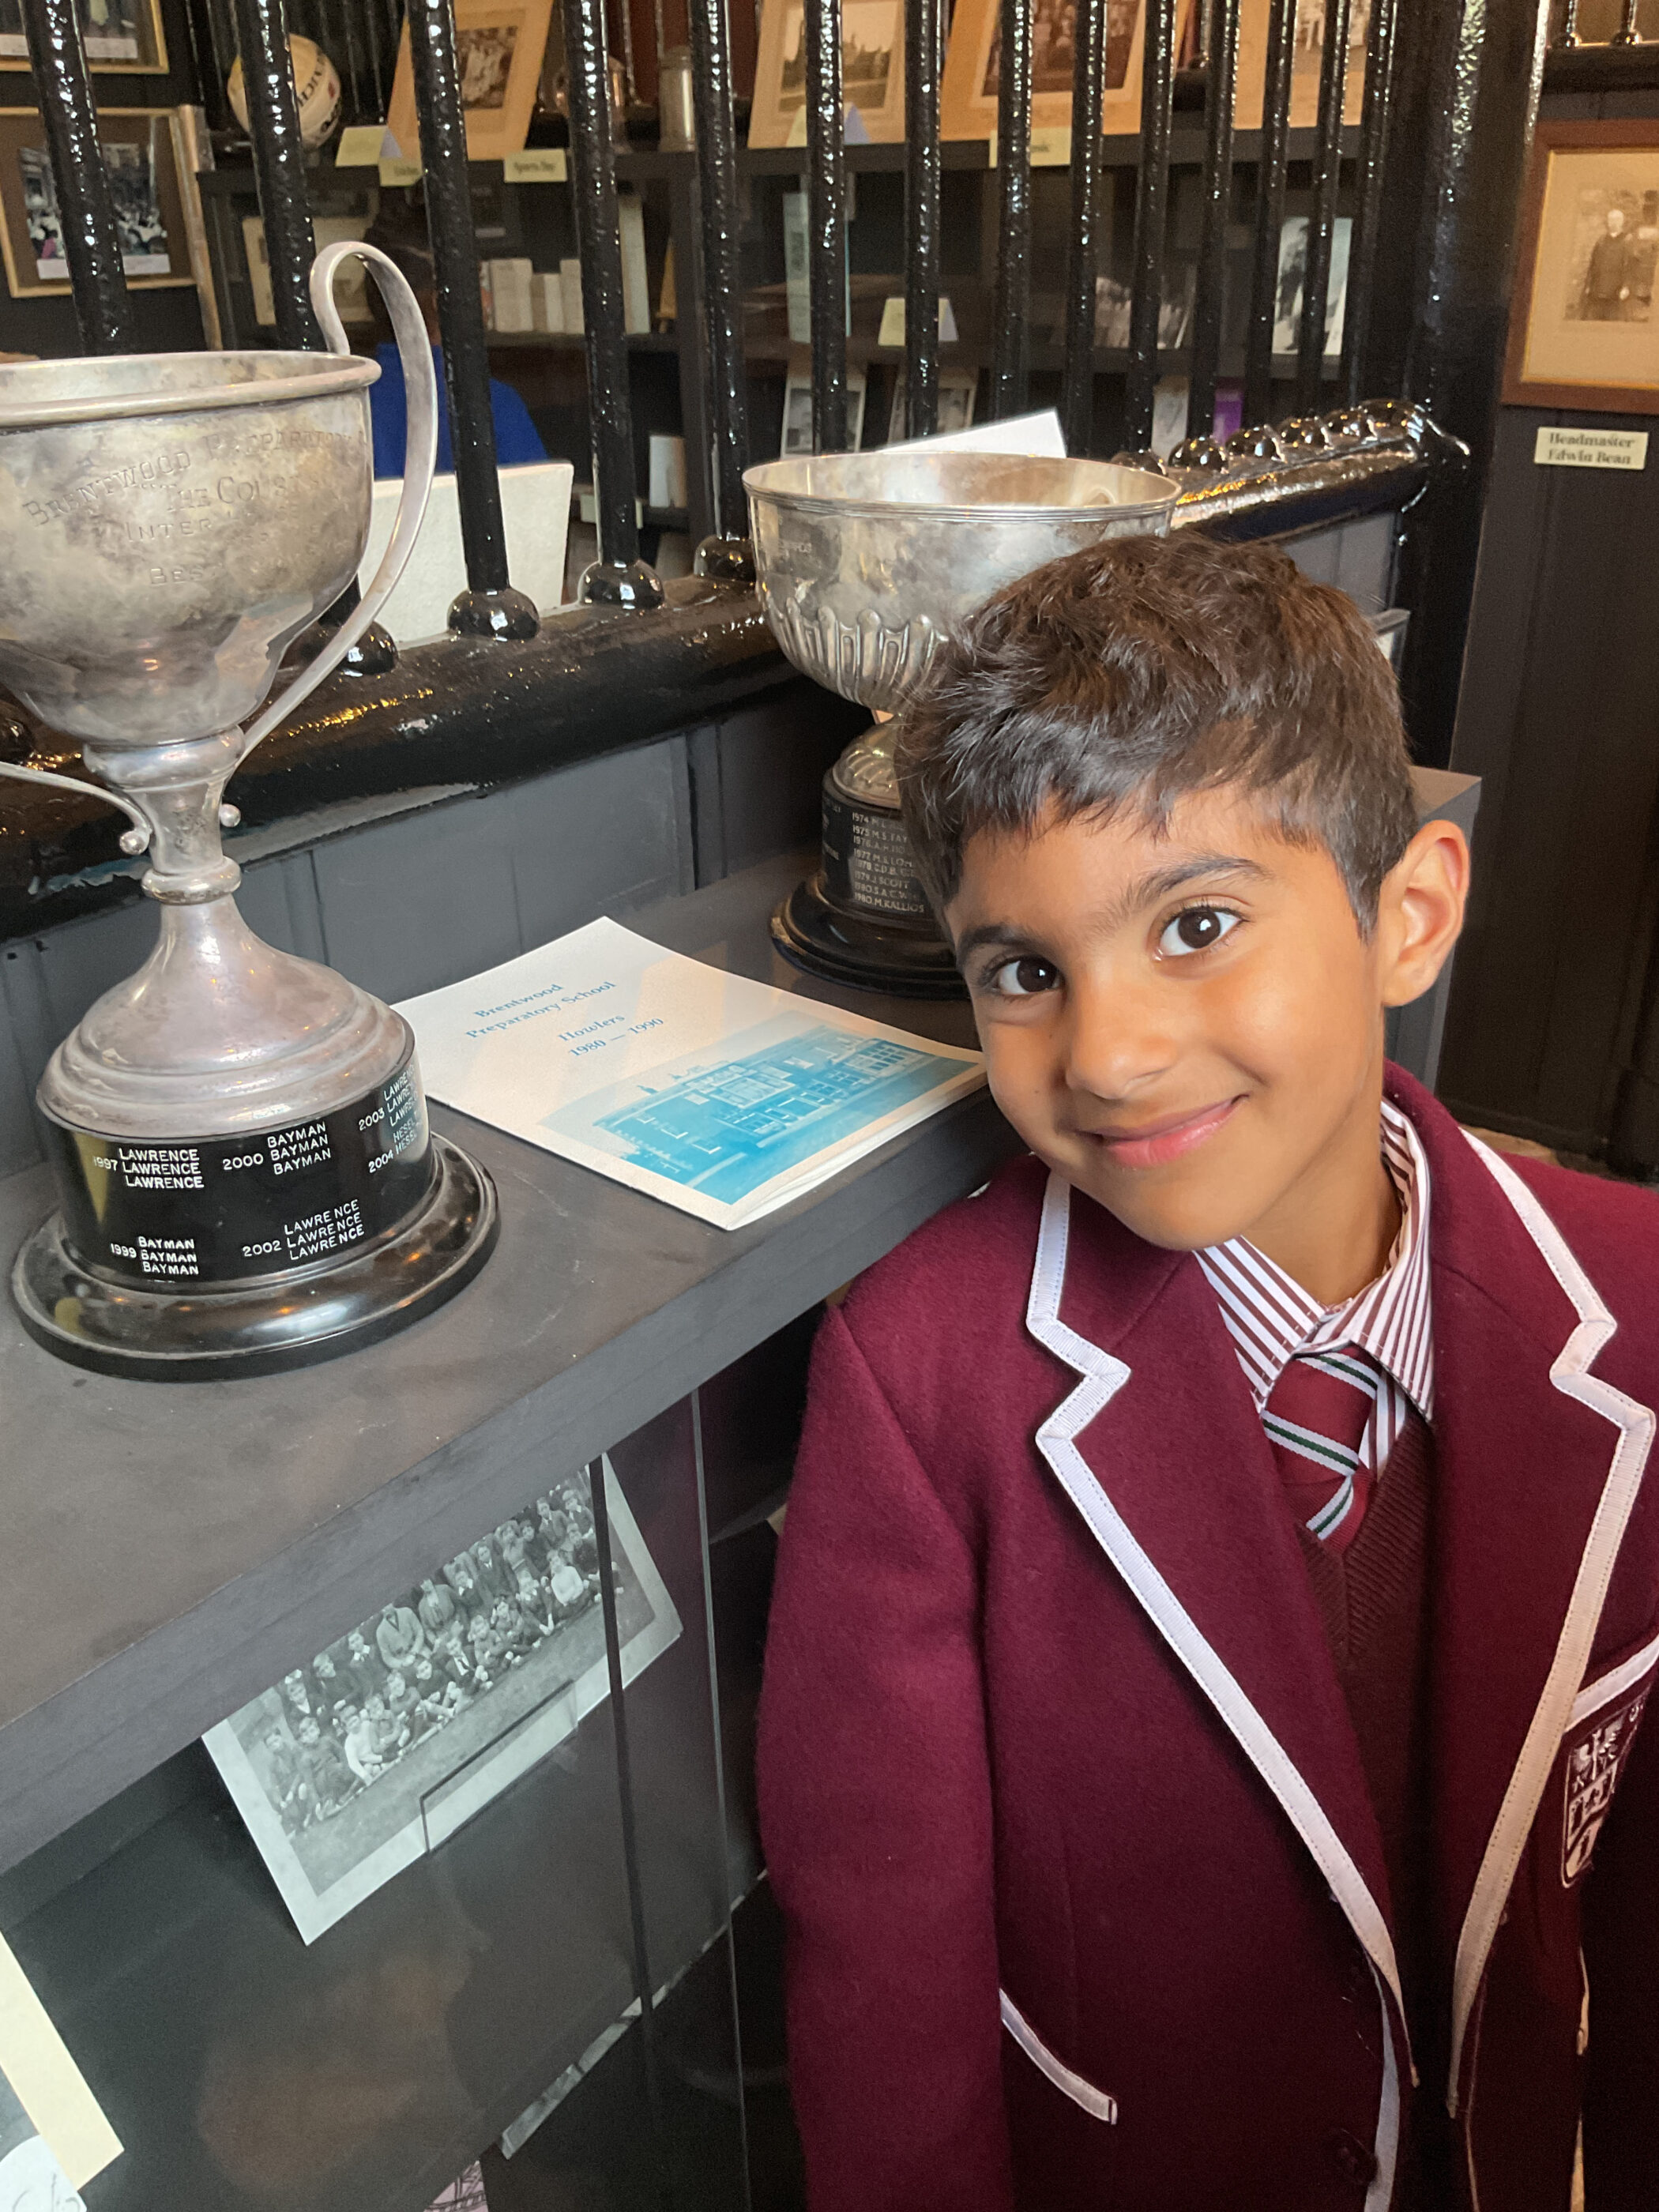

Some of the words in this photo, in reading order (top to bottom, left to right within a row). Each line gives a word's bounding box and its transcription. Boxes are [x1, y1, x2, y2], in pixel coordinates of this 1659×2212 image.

[1549, 432, 1635, 448] Headmaster
[1548, 449, 1593, 461] Edwin
[1597, 451, 1631, 465] Bean
[22, 451, 191, 526] BRENTWOOD
[465, 1003, 562, 1038] Preparatory
[561, 980, 617, 1004] School
[474, 983, 564, 1018] Brentwood
[558, 1014, 626, 1042] Howlers
[568, 1039, 607, 1056] 1980
[627, 1017, 664, 1036] 1990
[359, 1107, 386, 1130] 2003
[267, 1121, 326, 1149] BAYMAN
[118, 1148, 200, 1162] LAWRENCE
[222, 1153, 264, 1170] 2000
[270, 1134, 329, 1161] BAYMAN
[273, 1148, 332, 1176] BAYMAN
[368, 1149, 393, 1174] 2004
[93, 1156, 118, 1171] 1997
[122, 1161, 201, 1175] LAWRENCE
[125, 1175, 205, 1189] LAWRENCE
[110, 1243, 137, 1258] 1999
[141, 1249, 198, 1262] BAYMAN
[137, 1236, 195, 1249] BAYMAN
[242, 1240, 282, 1257] 2002
[142, 1261, 199, 1275] BAYMAN
